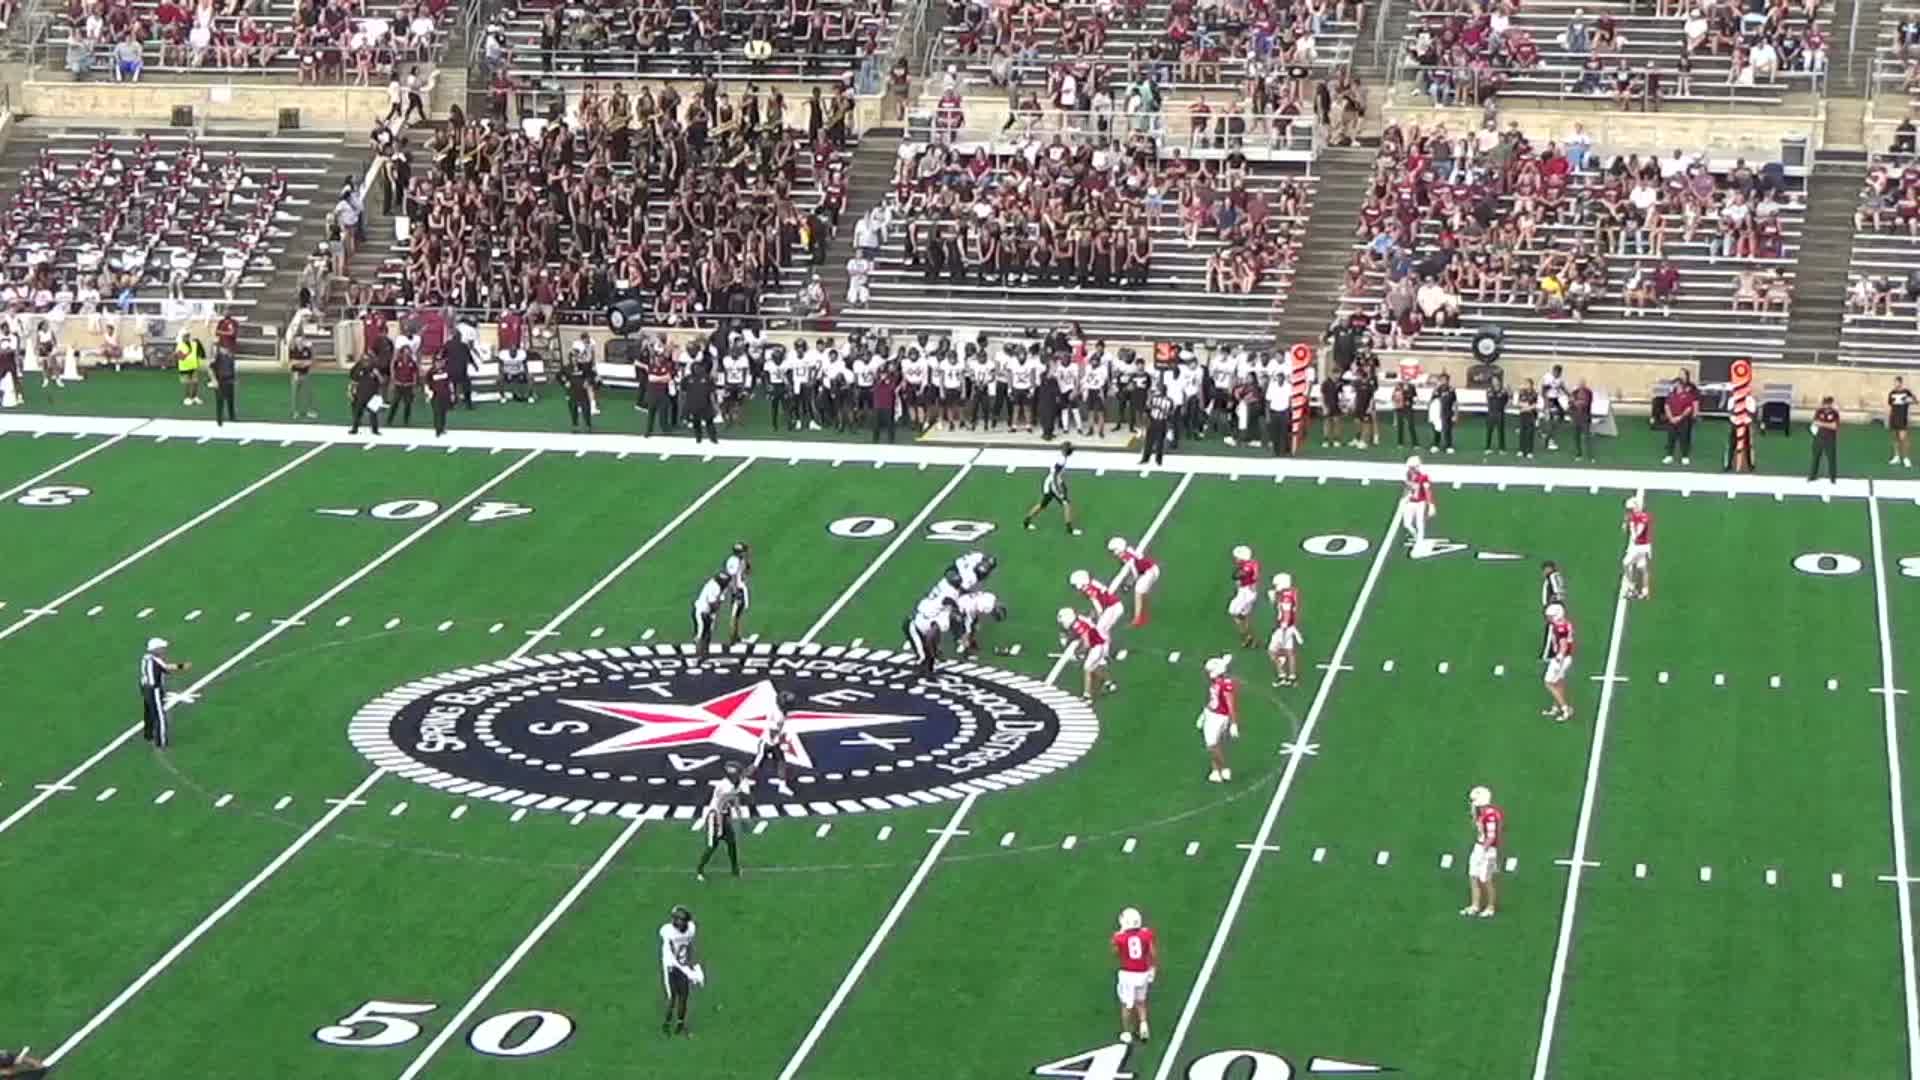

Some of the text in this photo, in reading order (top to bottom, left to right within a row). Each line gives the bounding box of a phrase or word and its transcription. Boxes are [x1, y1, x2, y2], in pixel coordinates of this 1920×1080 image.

[433, 665, 598, 706] BRANCH
[935, 720, 1046, 775] DISTRICT
[1127, 935, 1143, 960] 8
[315, 1001, 576, 1056] 50
